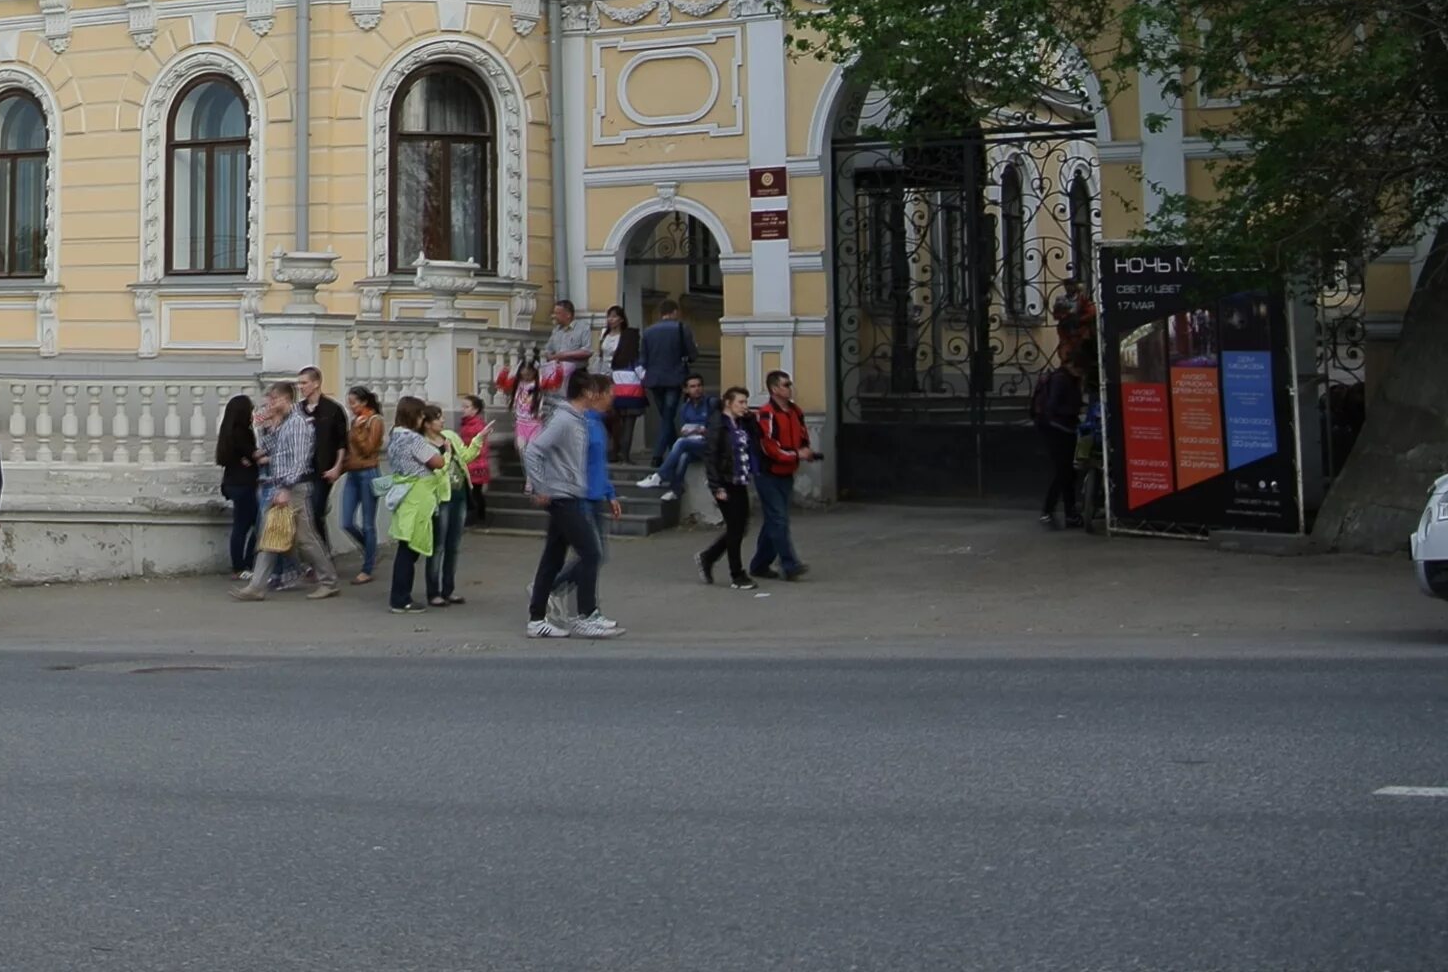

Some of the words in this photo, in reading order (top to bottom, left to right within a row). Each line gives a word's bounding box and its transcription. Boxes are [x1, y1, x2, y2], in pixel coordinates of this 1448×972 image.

[1113, 257, 1172, 274] НОЧЬ
[1115, 284, 1142, 295] СВЕТ
[1144, 284, 1153, 295] И
[1154, 284, 1182, 295] ЦВЕТ
[1117, 301, 1130, 311] 17
[1132, 301, 1156, 311] МАЯ
